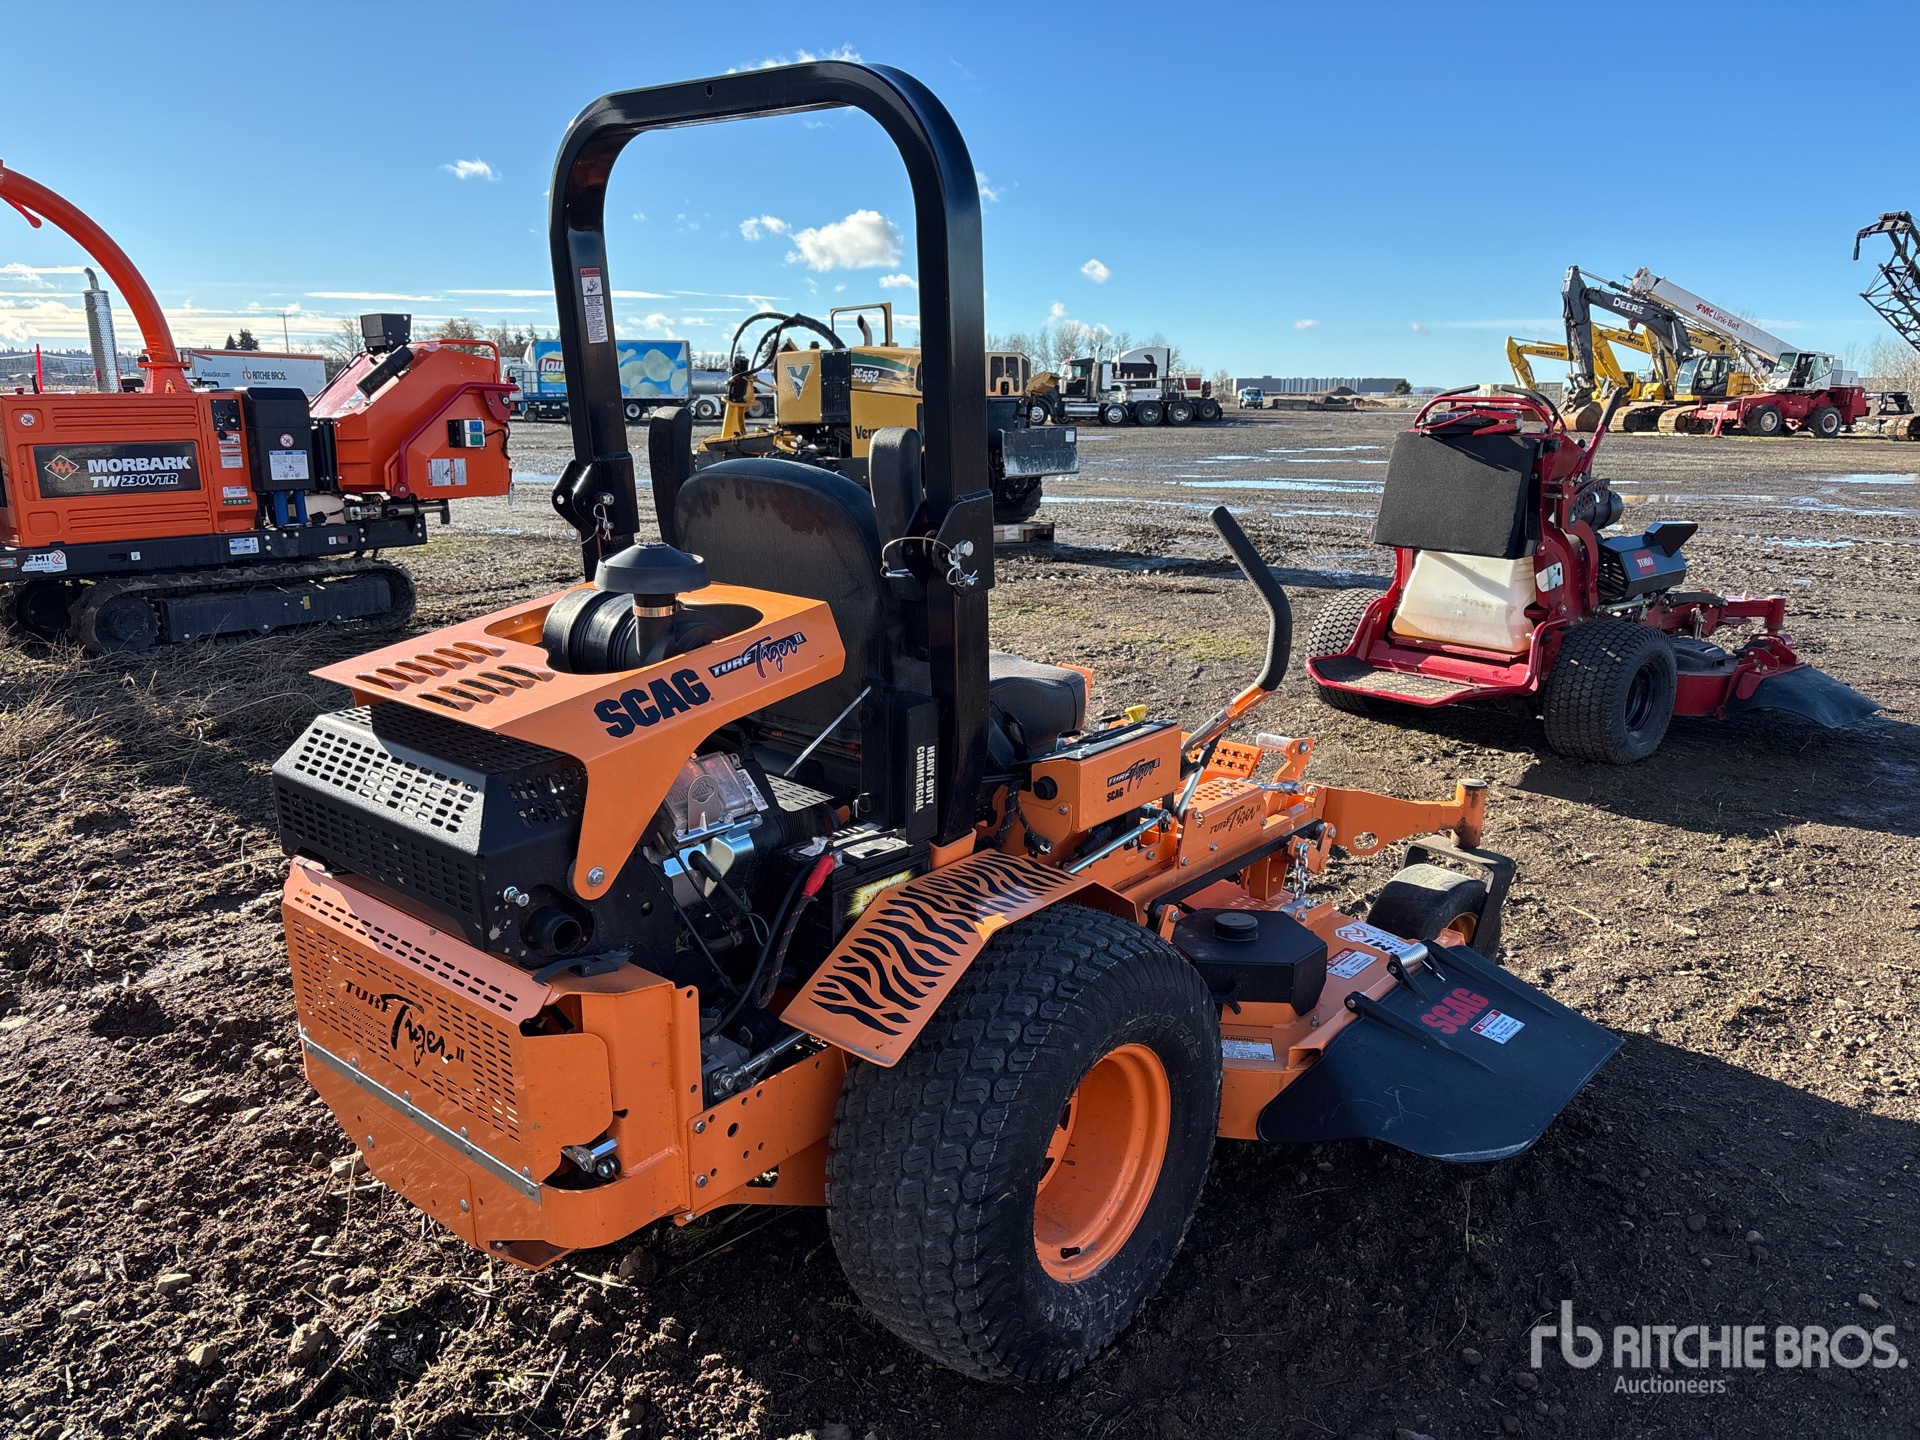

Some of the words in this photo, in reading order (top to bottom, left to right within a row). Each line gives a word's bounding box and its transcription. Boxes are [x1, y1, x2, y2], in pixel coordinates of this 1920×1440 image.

[1612, 297, 1645, 315] DEERE
[1696, 303, 1714, 317] FMC
[1536, 349, 1565, 357] KOMATSU
[540, 358, 565, 375] Lay
[853, 367, 880, 383] SC552
[252, 371, 271, 380] RITCHIE
[855, 425, 875, 440] Ver
[87, 456, 192, 474] MORBARK
[1636, 556, 1655, 568] TORO
[711, 651, 753, 677] TURF
[741, 636, 799, 679] Tiger
[594, 668, 711, 738] SCAG
[915, 745, 925, 812] COMMERCIAL
[925, 745, 936, 804] HEAVY-DUTY
[1108, 769, 1131, 786] TURF
[1106, 787, 1124, 803] SCAG
[1209, 816, 1231, 835] TURF
[1363, 938, 1398, 954] MI
[1420, 987, 1489, 1034] SCAG
[345, 980, 393, 1013] TURF
[380, 994, 454, 1067] Tiger
